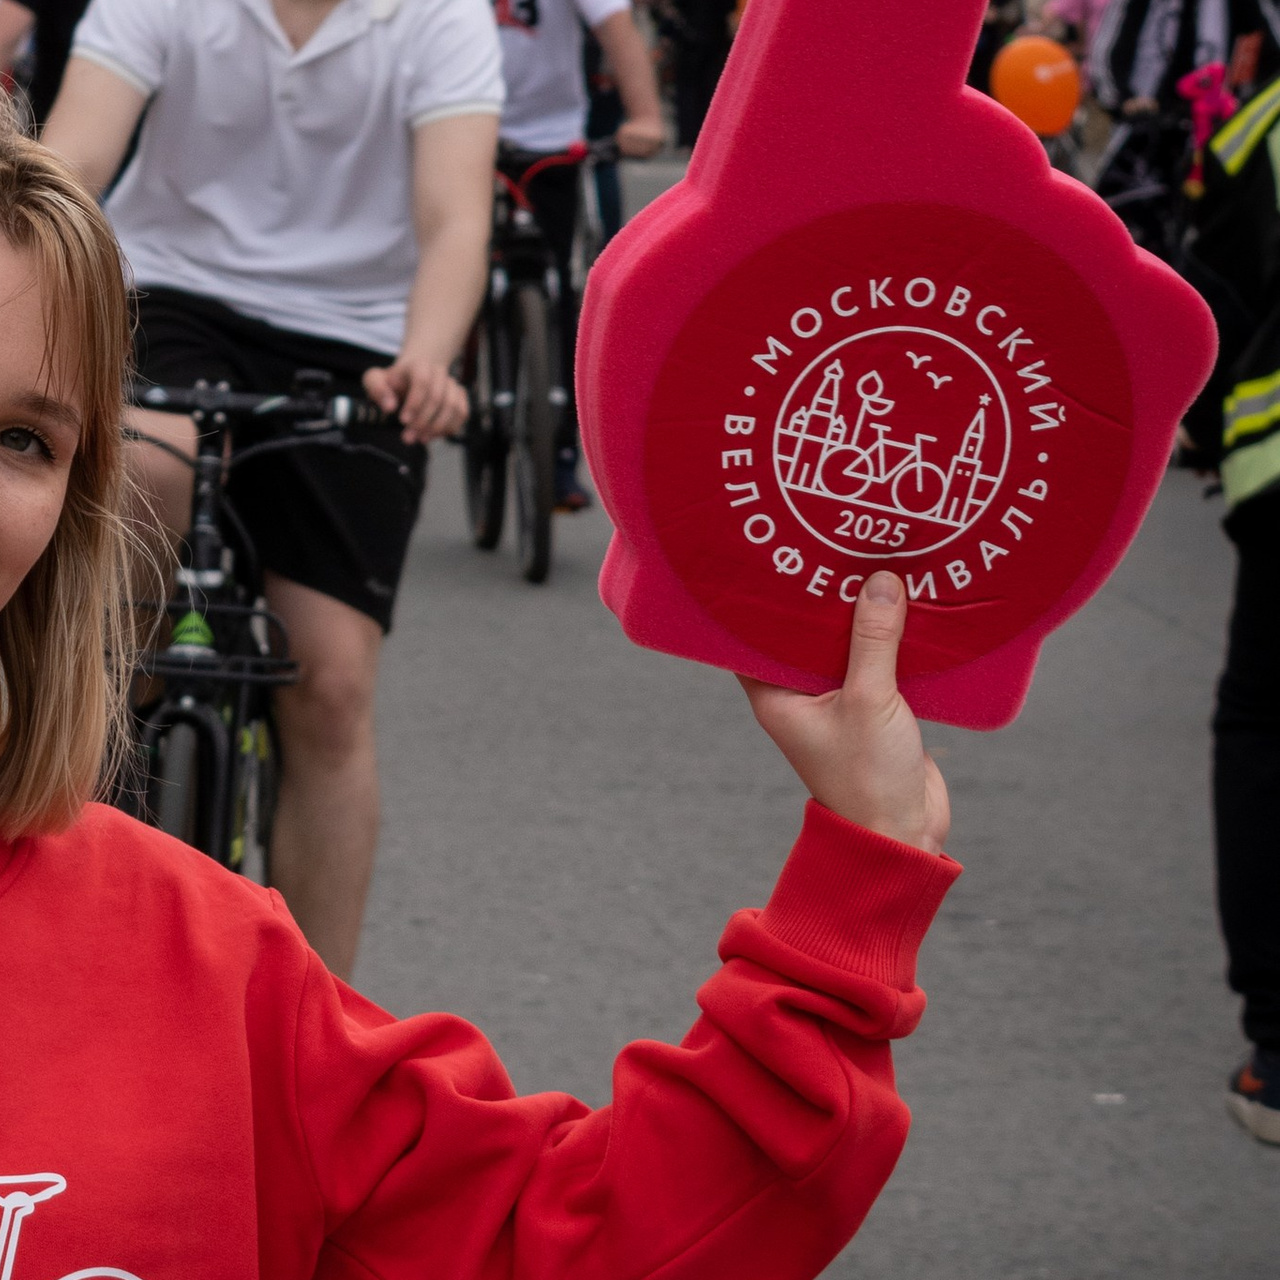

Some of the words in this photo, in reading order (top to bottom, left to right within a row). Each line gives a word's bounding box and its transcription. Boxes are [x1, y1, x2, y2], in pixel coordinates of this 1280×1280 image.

[752, 277, 1066, 432] МОСКОВСКИЙ
[721, 414, 1050, 603] ВЕЛОФЕСИВАЛЬ
[834, 510, 910, 547] 2025
